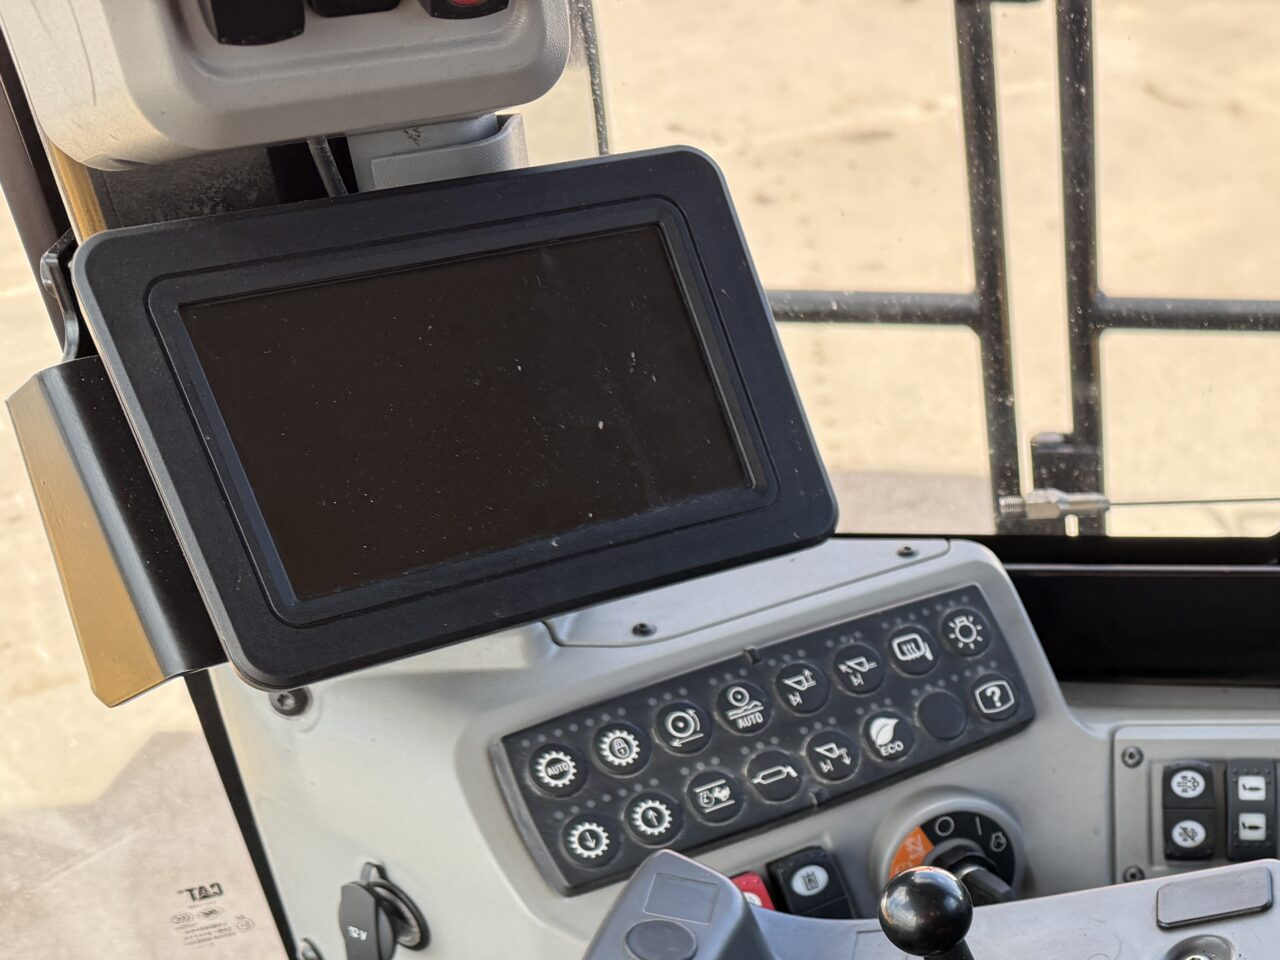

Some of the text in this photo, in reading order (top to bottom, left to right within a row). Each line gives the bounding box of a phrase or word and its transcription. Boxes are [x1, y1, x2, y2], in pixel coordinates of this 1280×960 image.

[738, 711, 764, 729] AUTO
[880, 740, 904, 756] ECO
[547, 762, 570, 776] AUTO
